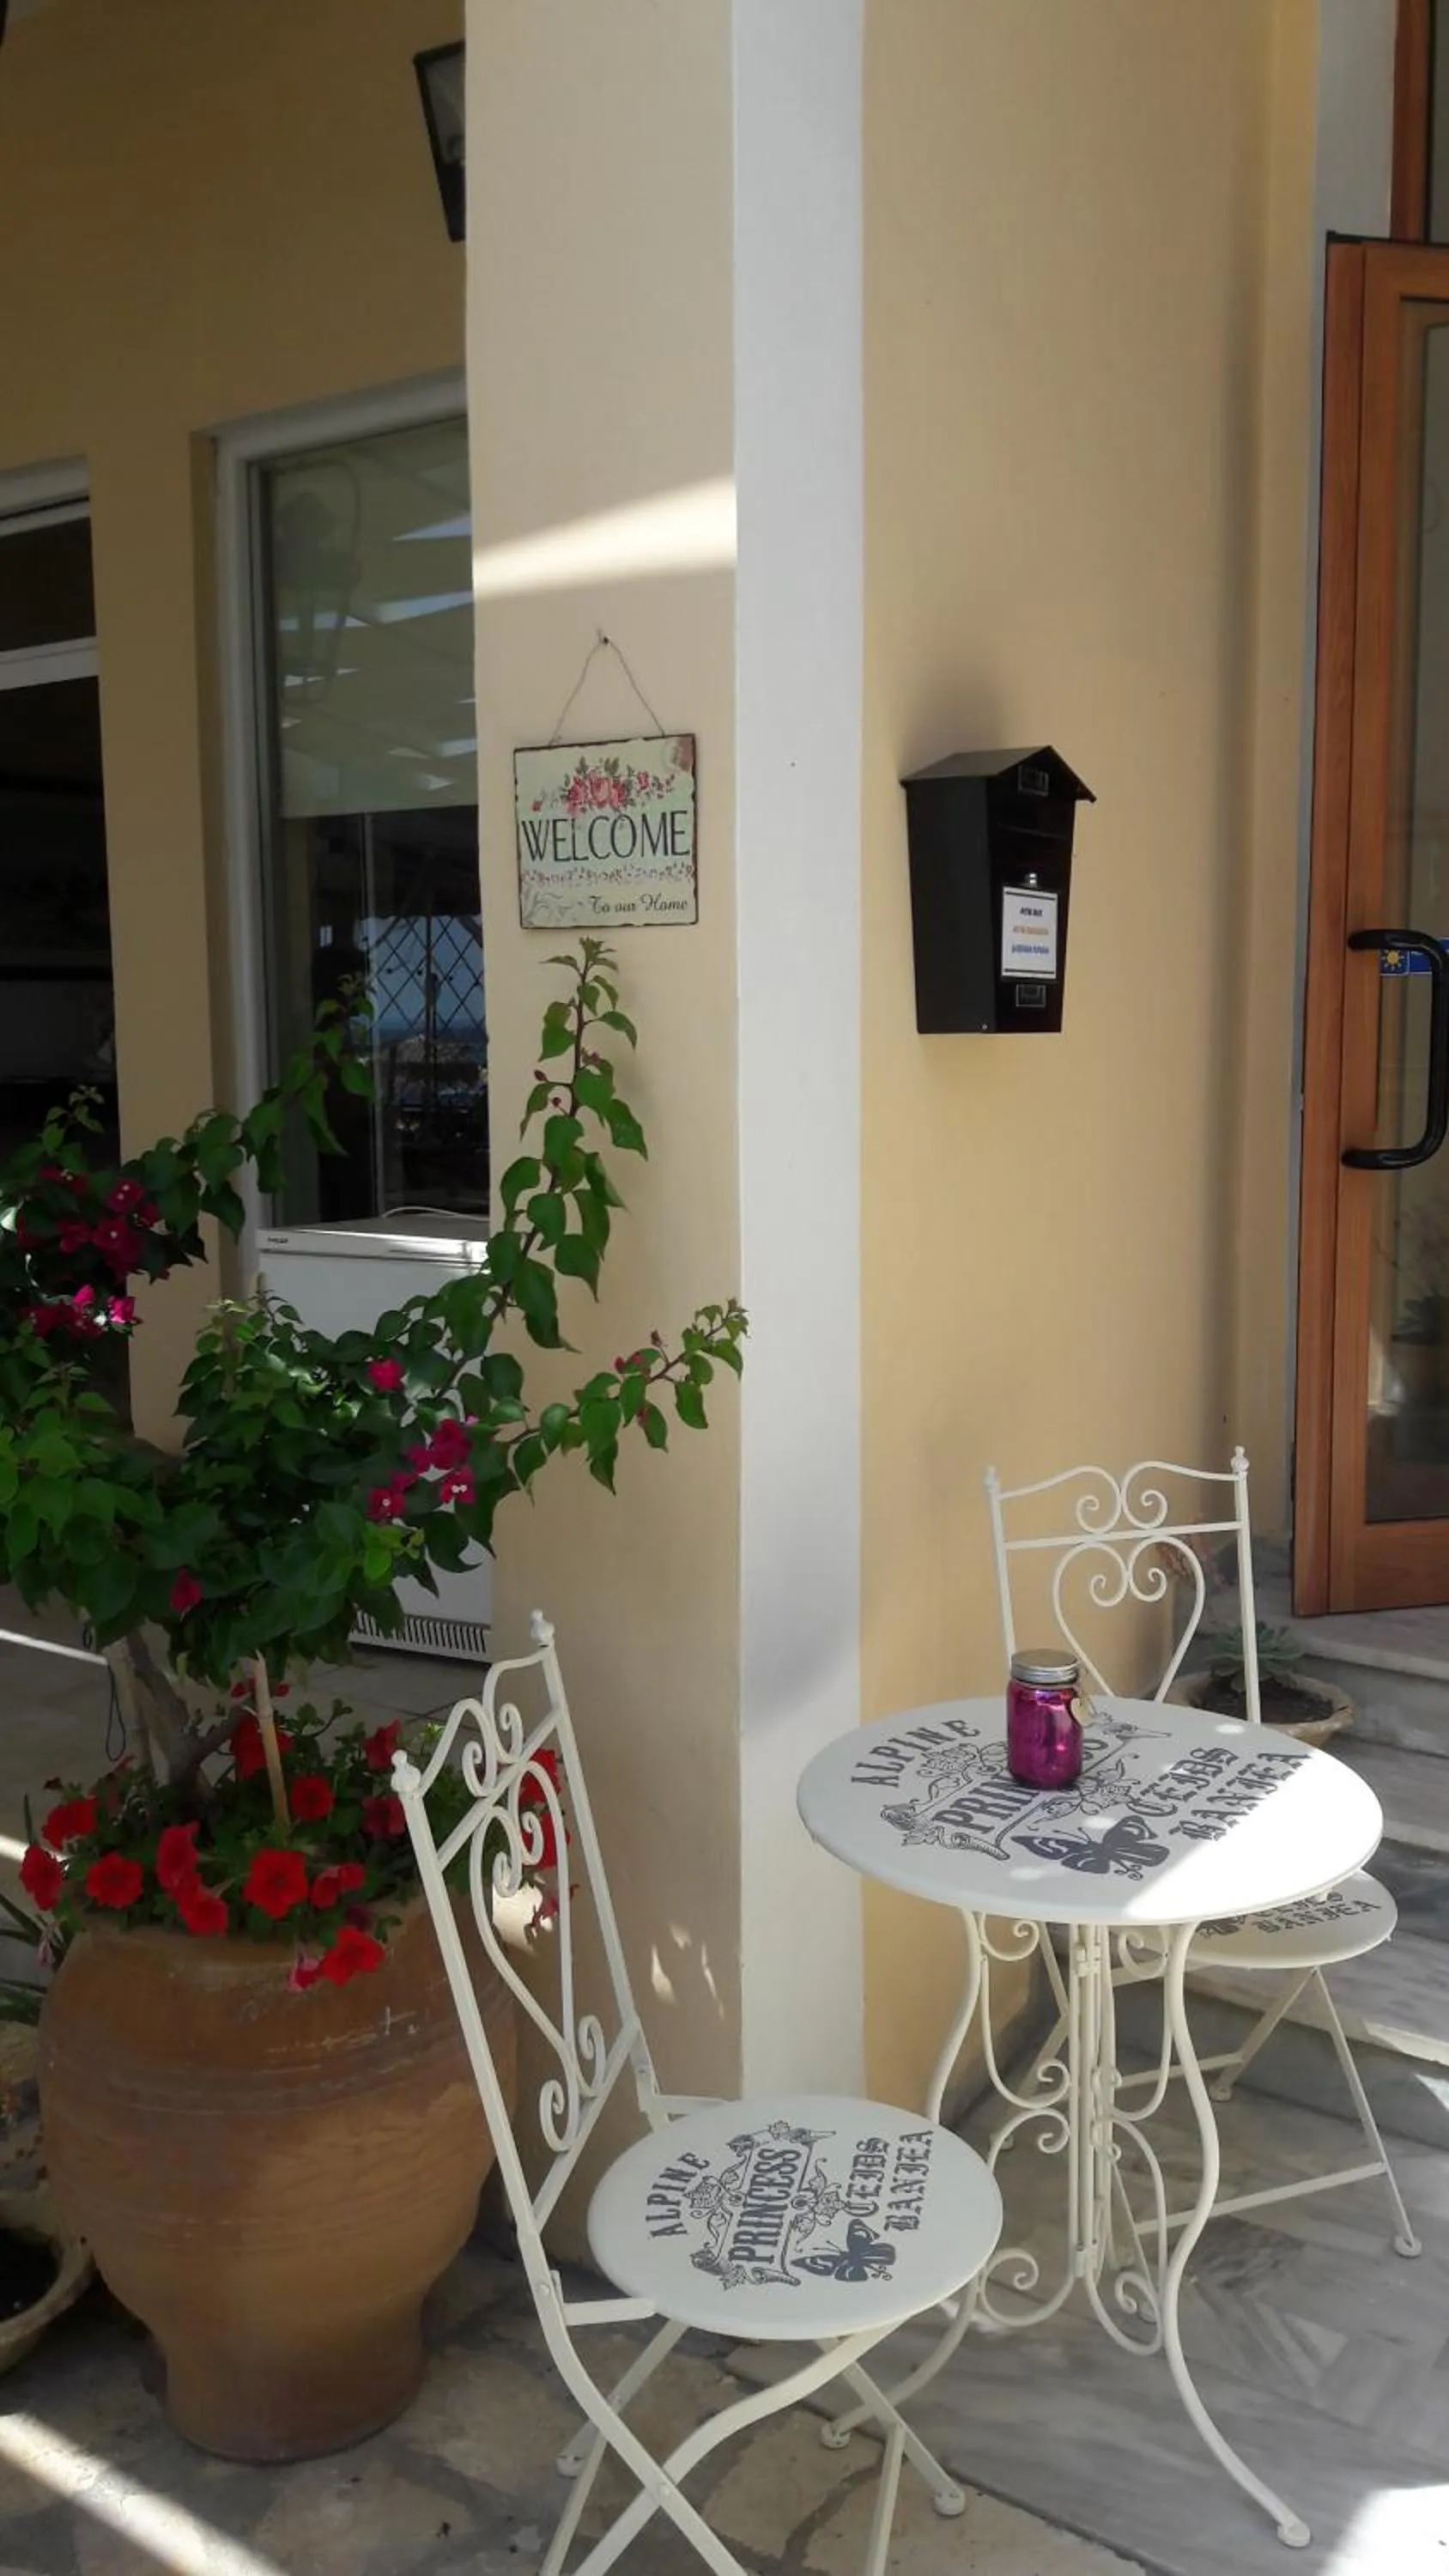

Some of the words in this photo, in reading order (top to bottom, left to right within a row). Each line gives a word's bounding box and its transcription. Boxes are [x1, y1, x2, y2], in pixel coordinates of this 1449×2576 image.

[521, 810, 690, 862] WELCOME
[589, 896, 610, 914] To
[615, 902, 636, 914] our
[640, 892, 688, 914] Home
[851, 1719, 980, 1789] ALPINE
[646, 2151, 710, 2237] ALPINE
[728, 2148, 802, 2264] PRINCESS
